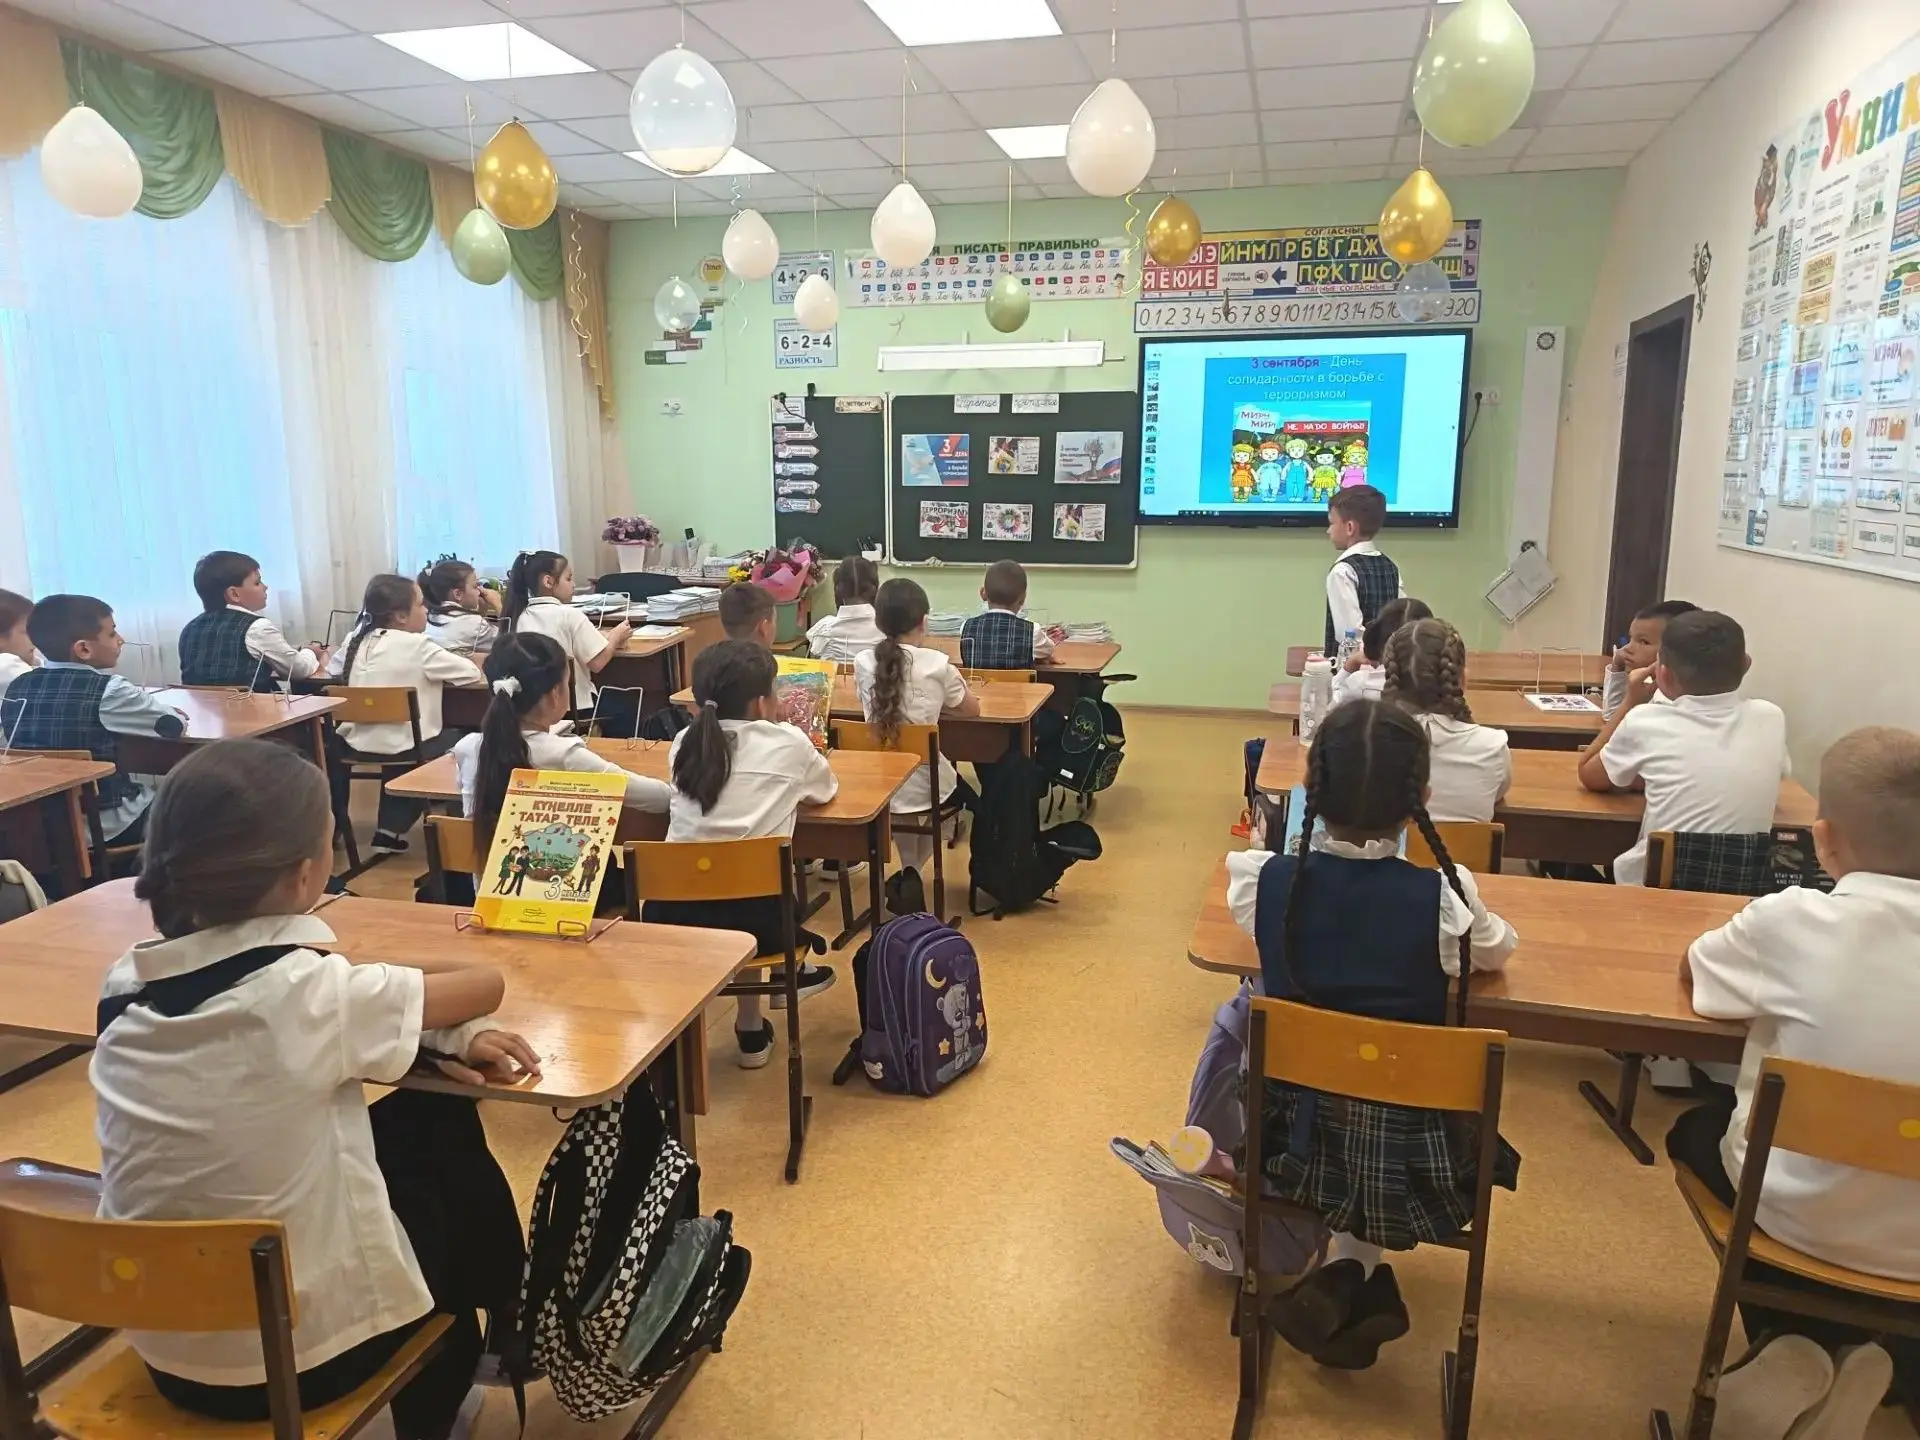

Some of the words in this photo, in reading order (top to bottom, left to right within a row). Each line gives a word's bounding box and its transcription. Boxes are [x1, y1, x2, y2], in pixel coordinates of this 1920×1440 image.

[954, 243, 1006, 255] ПИСАТЬ
[1019, 239, 1100, 252] ПРАВИЛЬНО
[779, 356, 823, 364] РАЗНОСТЬ
[1252, 358, 1259, 368] 3
[1262, 356, 1320, 370] сентября
[1329, 356, 1363, 368] День
[1228, 374, 1314, 386] солидарности
[1317, 374, 1326, 382] в
[1328, 371, 1374, 384] борьбе
[1263, 390, 1346, 402] терроризмом
[1286, 422, 1298, 430] НЕ
[519, 811, 560, 824] ТАТАР
[544, 874, 561, 900] 3
